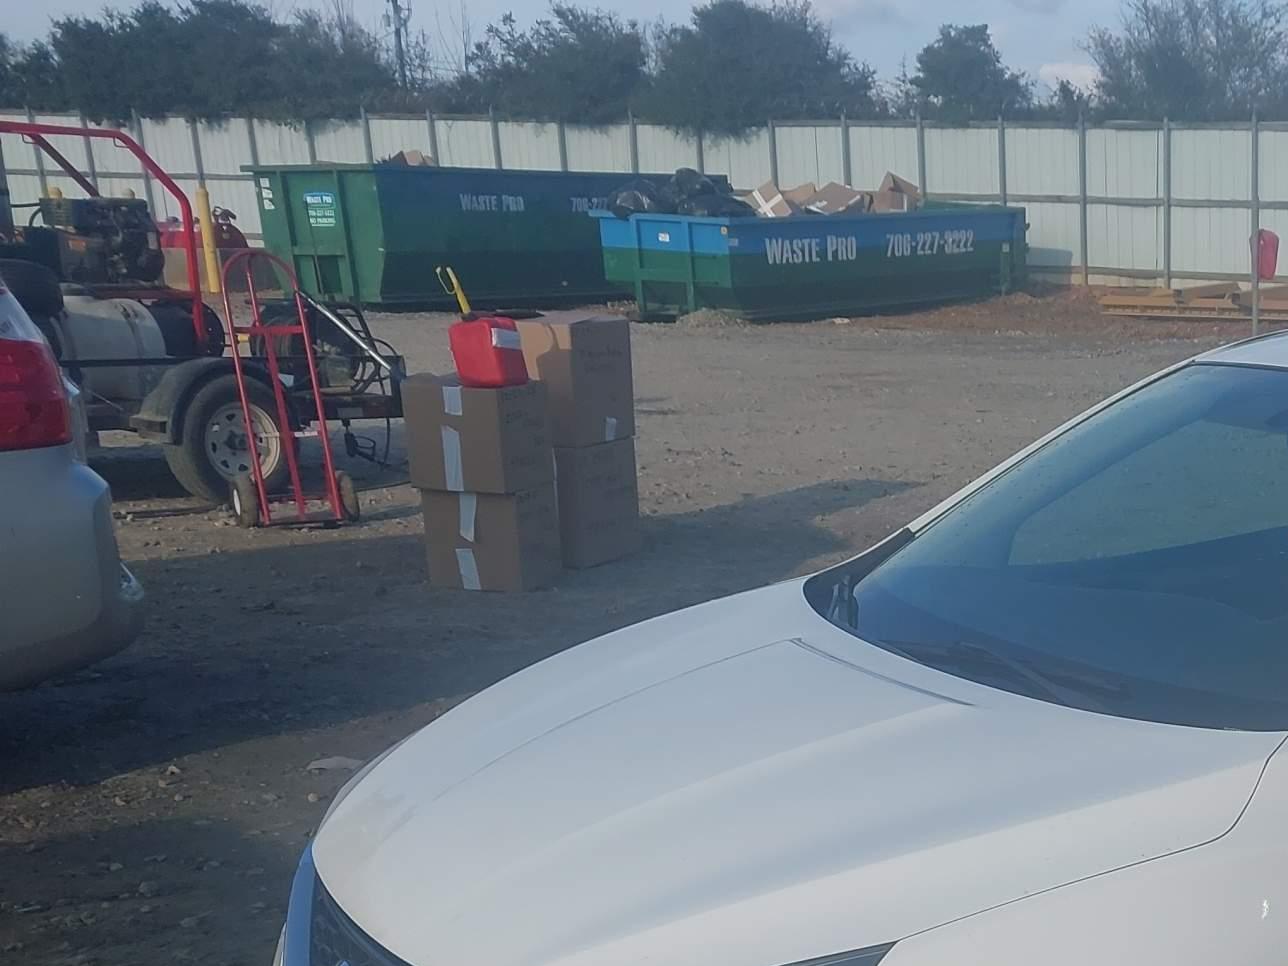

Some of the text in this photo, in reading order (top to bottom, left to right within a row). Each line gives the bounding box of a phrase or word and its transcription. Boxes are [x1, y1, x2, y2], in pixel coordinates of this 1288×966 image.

[460, 193, 498, 211] WASTE
[765, 237, 821, 265] WASTE
[826, 235, 857, 262] PRO
